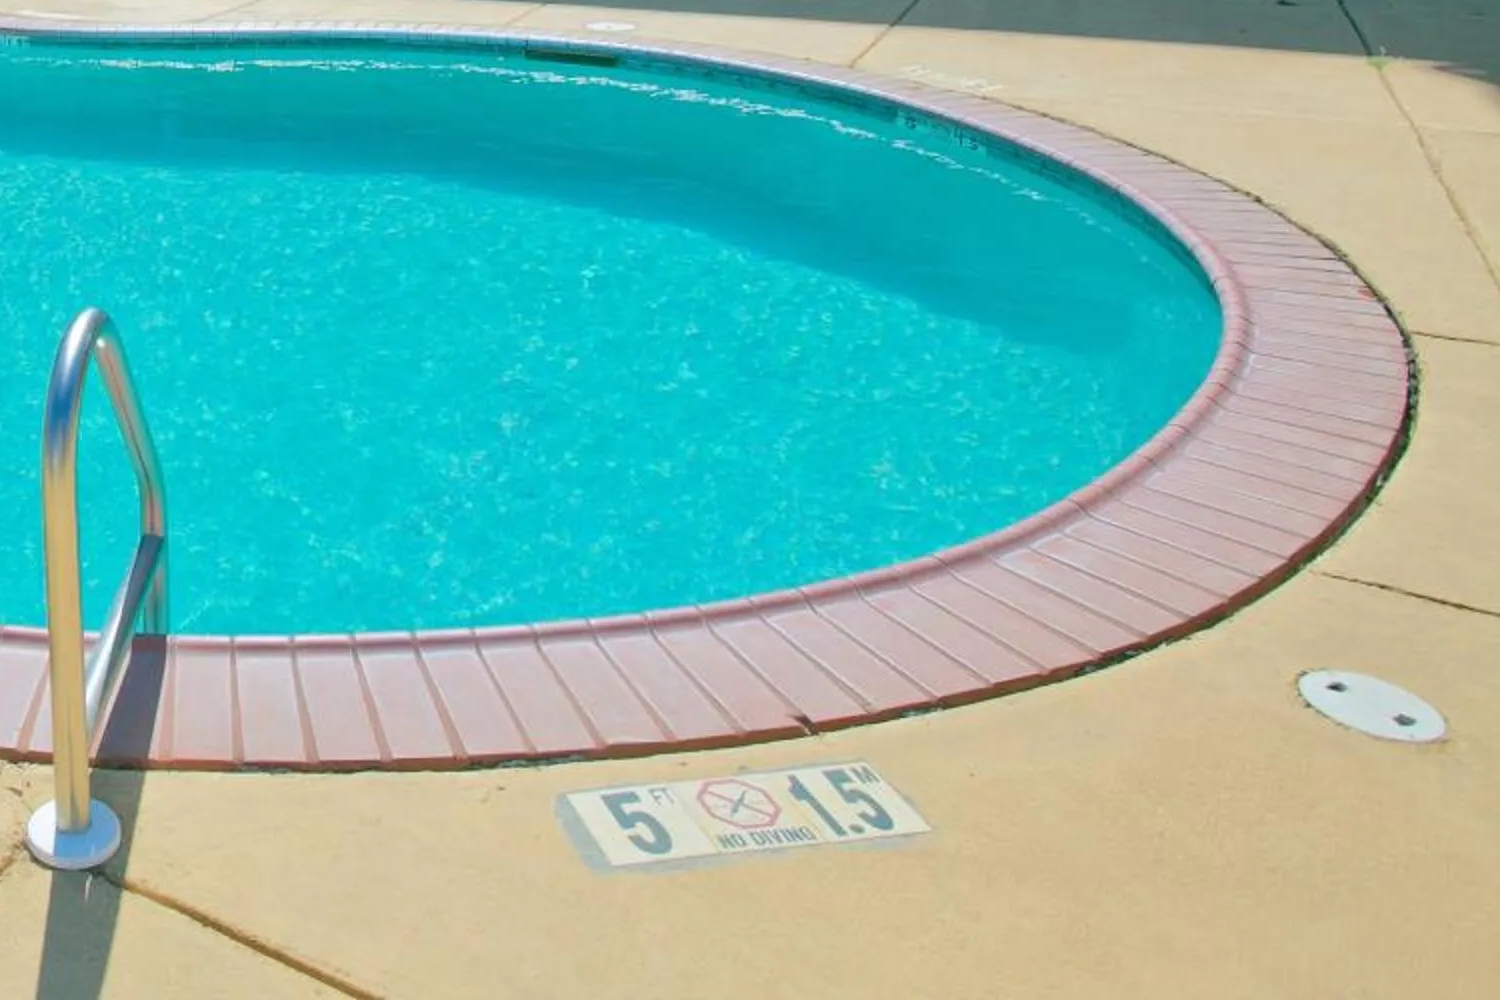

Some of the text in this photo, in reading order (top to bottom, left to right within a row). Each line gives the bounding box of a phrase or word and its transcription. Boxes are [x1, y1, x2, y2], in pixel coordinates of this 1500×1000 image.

[600, 787, 675, 854] 5 FT
[787, 768, 895, 837] 1.5
[717, 826, 817, 849] NO DIVING
